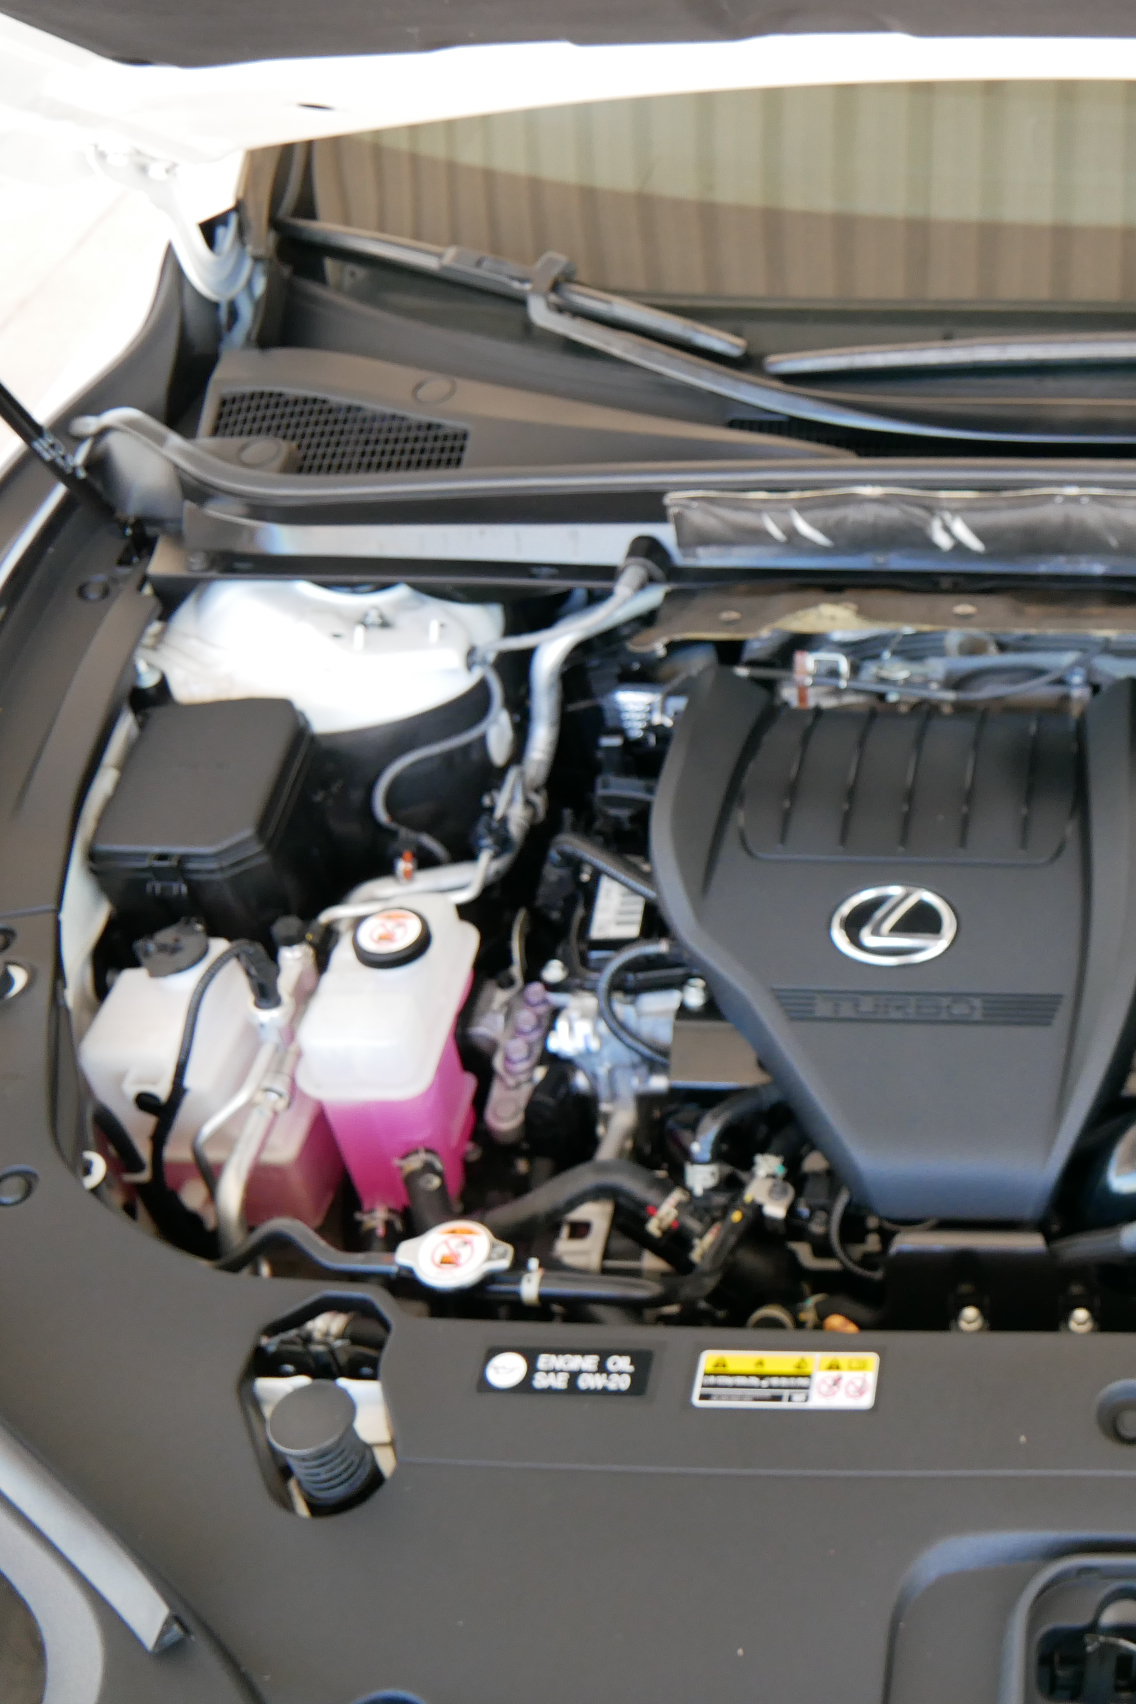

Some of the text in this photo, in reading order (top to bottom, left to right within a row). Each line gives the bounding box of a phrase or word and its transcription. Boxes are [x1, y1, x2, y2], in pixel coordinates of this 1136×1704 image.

[817, 994, 980, 1020] TURBO
[537, 1353, 635, 1373] ENGINE OIL
[532, 1371, 570, 1390] SAE
